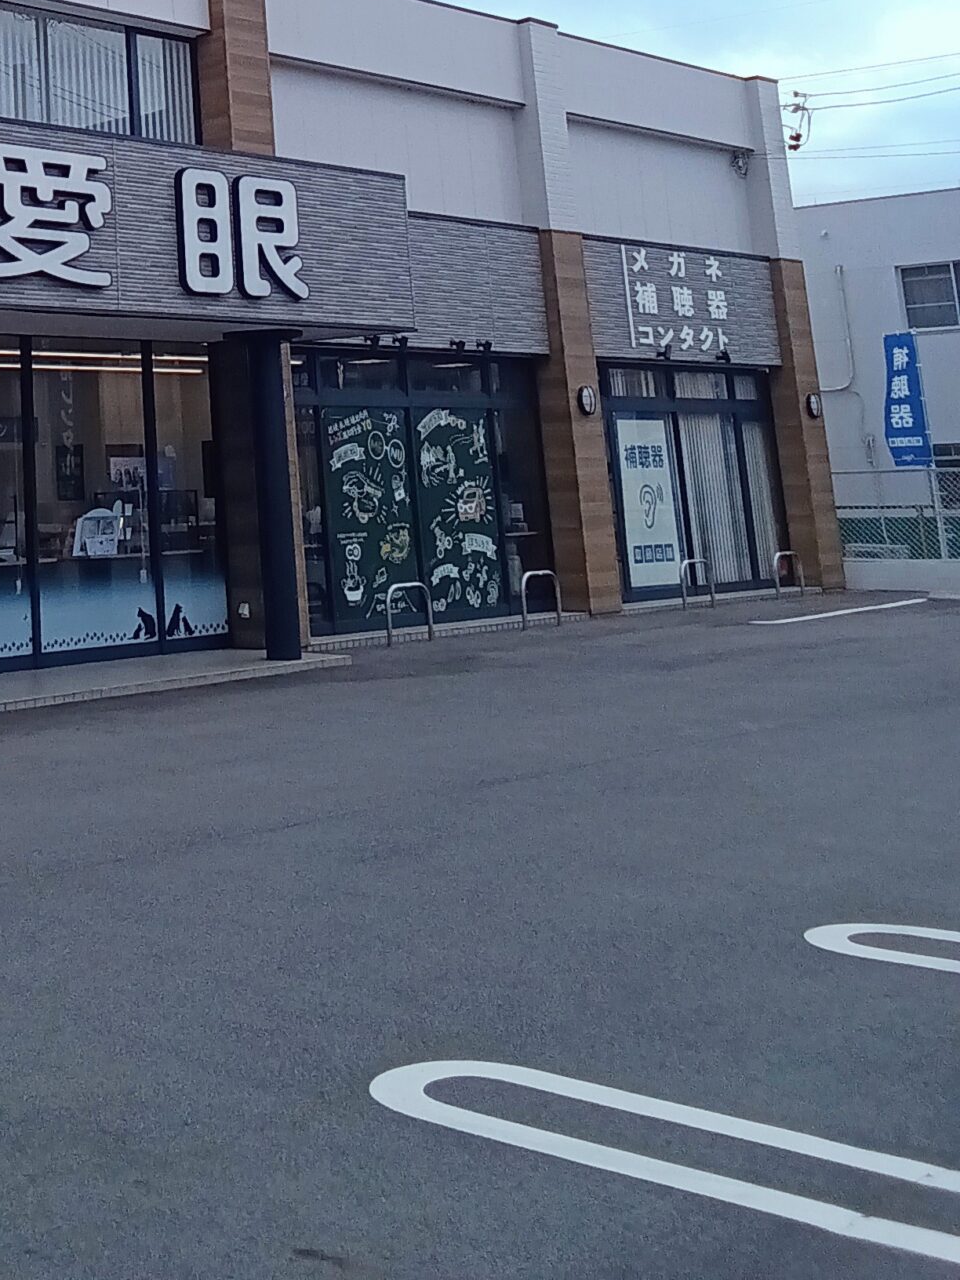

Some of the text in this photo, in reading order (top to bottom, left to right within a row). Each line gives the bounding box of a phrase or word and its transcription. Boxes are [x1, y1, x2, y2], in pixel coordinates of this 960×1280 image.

[631, 246, 722, 282] メガネ
[635, 281, 728, 320] 補聴器
[638, 325, 728, 351] コンタクト
[624, 444, 665, 469] 補聴器
